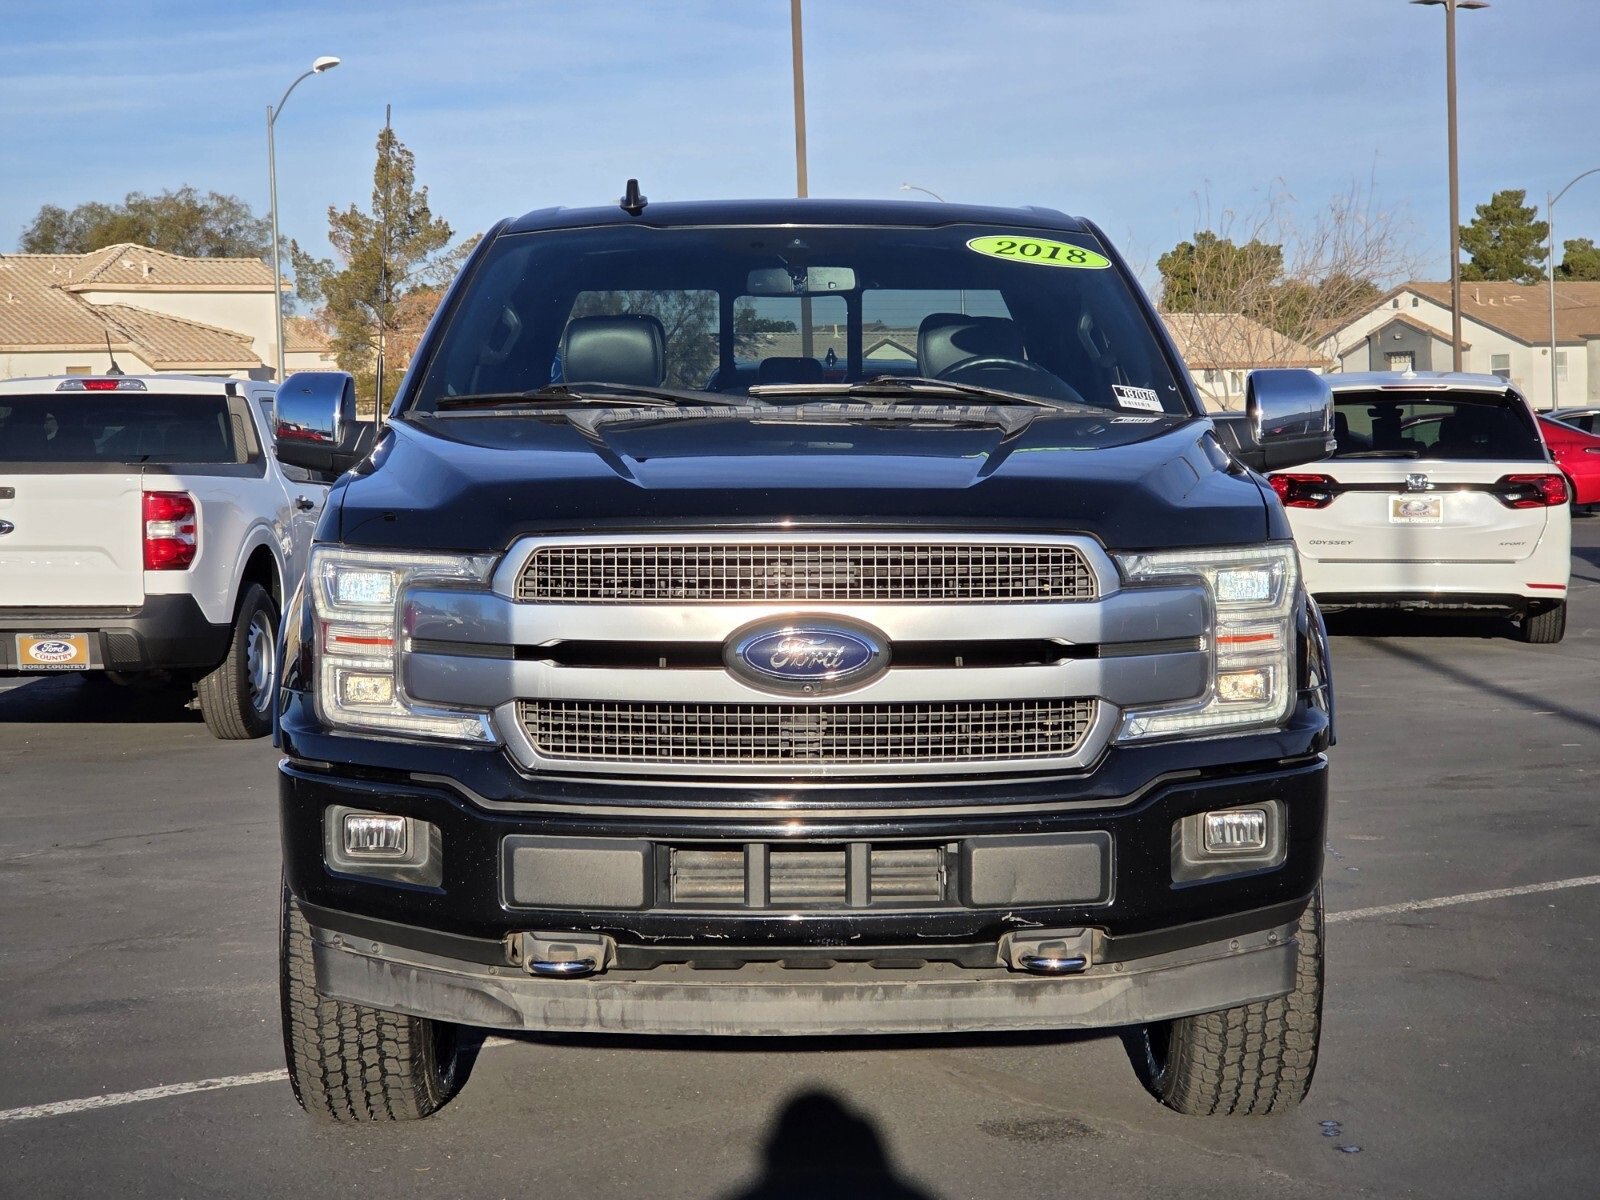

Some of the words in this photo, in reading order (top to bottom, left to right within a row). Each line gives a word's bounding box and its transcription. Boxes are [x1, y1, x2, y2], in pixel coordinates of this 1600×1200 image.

[994, 240, 1087, 264] 2018
[41, 642, 65, 653] Ford
[770, 636, 846, 669] Ford
[35, 652, 72, 661] COUNTRY
